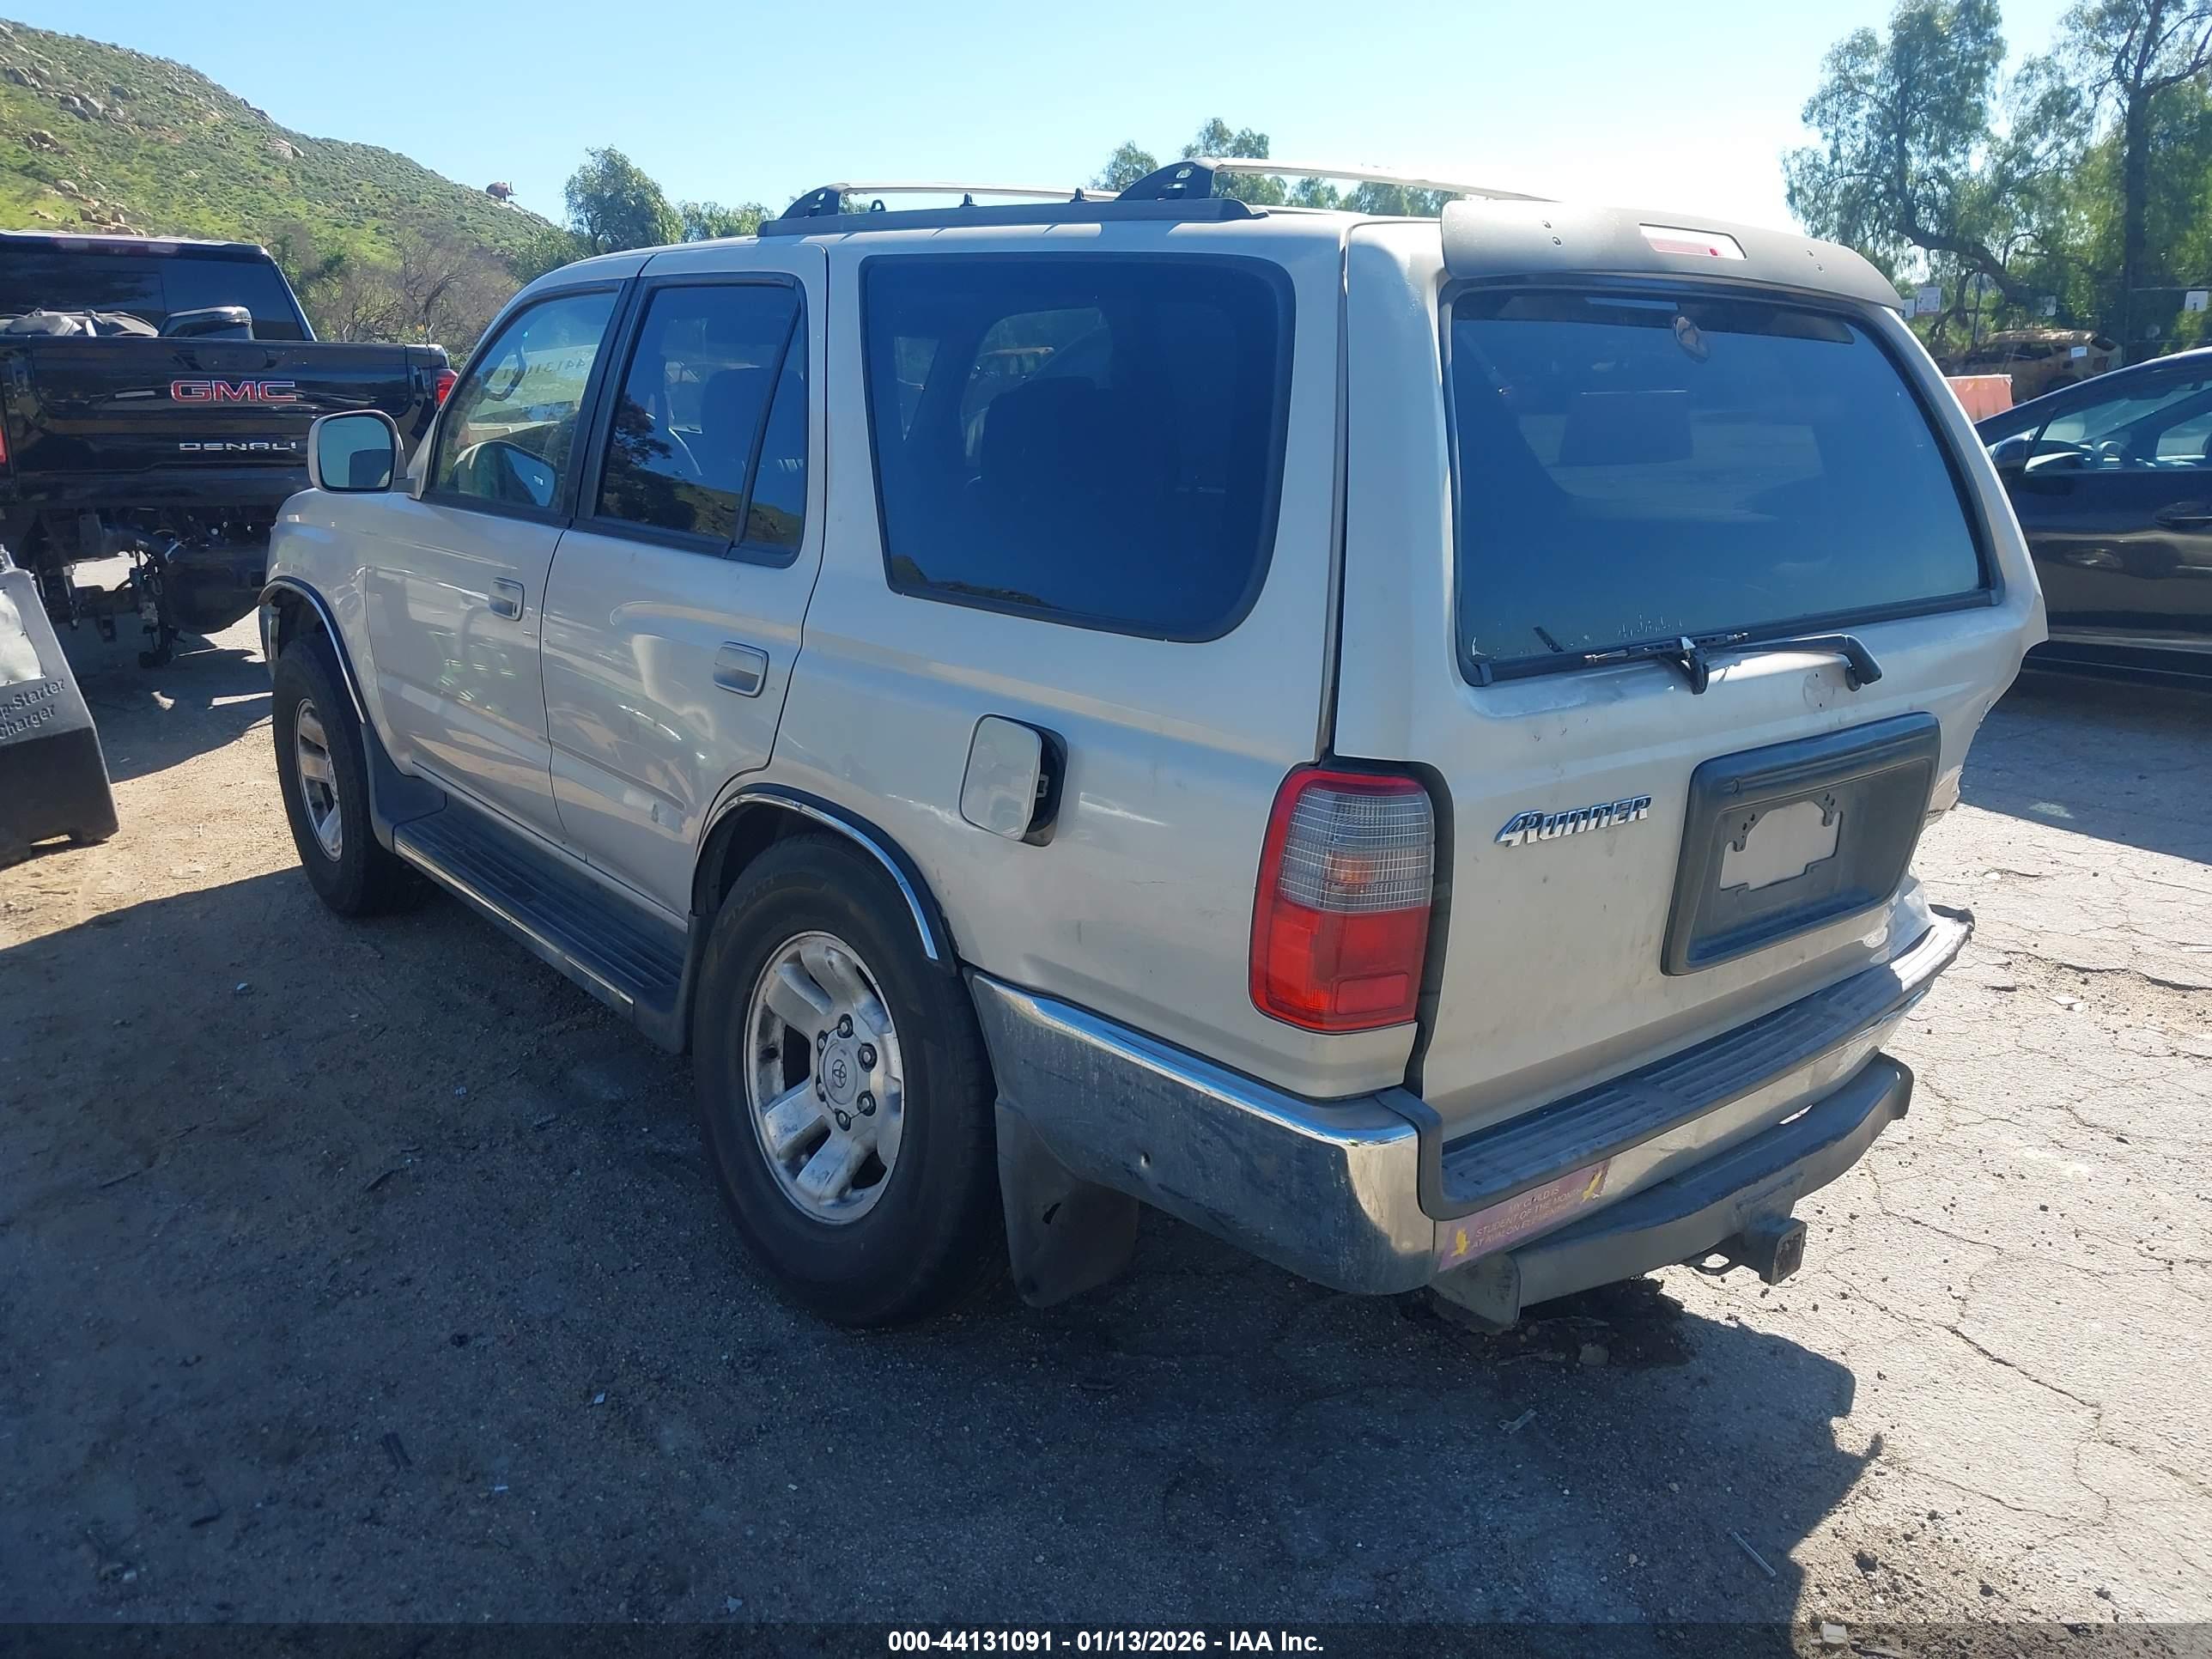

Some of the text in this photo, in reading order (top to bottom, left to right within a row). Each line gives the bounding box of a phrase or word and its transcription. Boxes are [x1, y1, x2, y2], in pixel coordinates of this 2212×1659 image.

[171, 380, 296, 402] GMC
[179, 441, 296, 451] DENALI
[1522, 1192, 1549, 1208] CHILD
[1550, 1185, 1561, 1197] IS
[1475, 1212, 1518, 1237] STUDENT
[1518, 1206, 1534, 1220] OF
[1534, 1198, 1552, 1214] THE
[1471, 1236, 1484, 1250] AT
